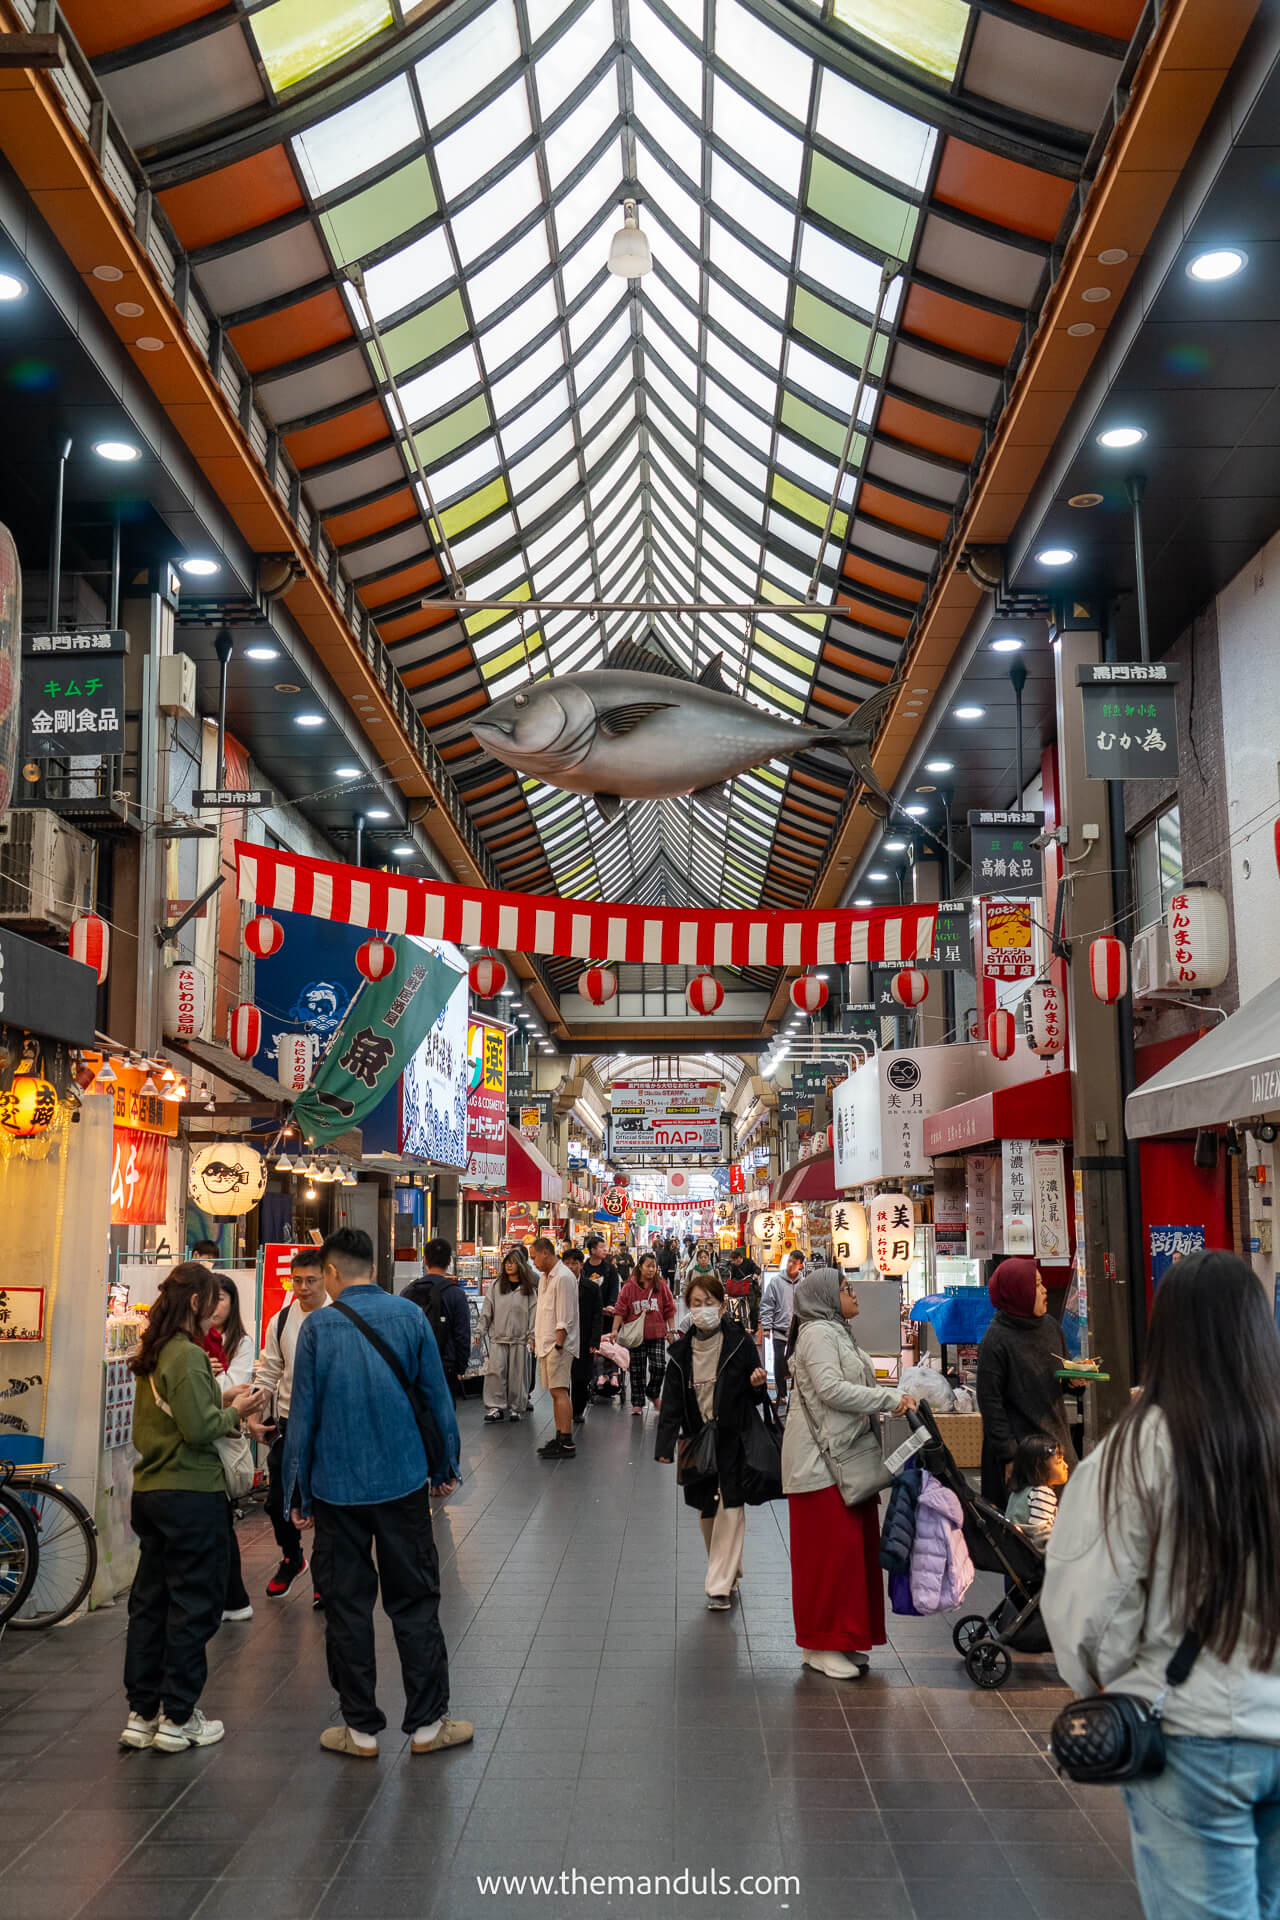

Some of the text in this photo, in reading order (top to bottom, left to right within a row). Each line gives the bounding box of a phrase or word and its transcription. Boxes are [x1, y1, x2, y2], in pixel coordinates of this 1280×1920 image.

[32, 634, 111, 650] 黒門市場
[1093, 666, 1167, 680] 黒門市場
[44, 678, 104, 697] キムチ
[31, 708, 119, 734] 金剛食品
[980, 812, 1035, 823] 黒門市場
[981, 858, 1034, 877] 高橋食品
[987, 905, 1016, 917] クロモン
[1171, 895, 1196, 981] ほんまもん
[987, 955, 1031, 963] STAMP
[990, 947, 1026, 955] フレッシュ
[987, 965, 1033, 975] 加盟店
[176, 970, 195, 1034] なにわの台所
[1042, 988, 1059, 1048] ほんまもん
[292, 1040, 306, 1089] なにわの台所
[888, 1093, 923, 1108] 美月
[656, 1131, 698, 1144] MAP
[1009, 1141, 1025, 1216] 特濃純豆乳
[834, 1209, 850, 1258] 美月
[891, 1204, 910, 1260] 美月
[632, 1298, 659, 1315] USA
